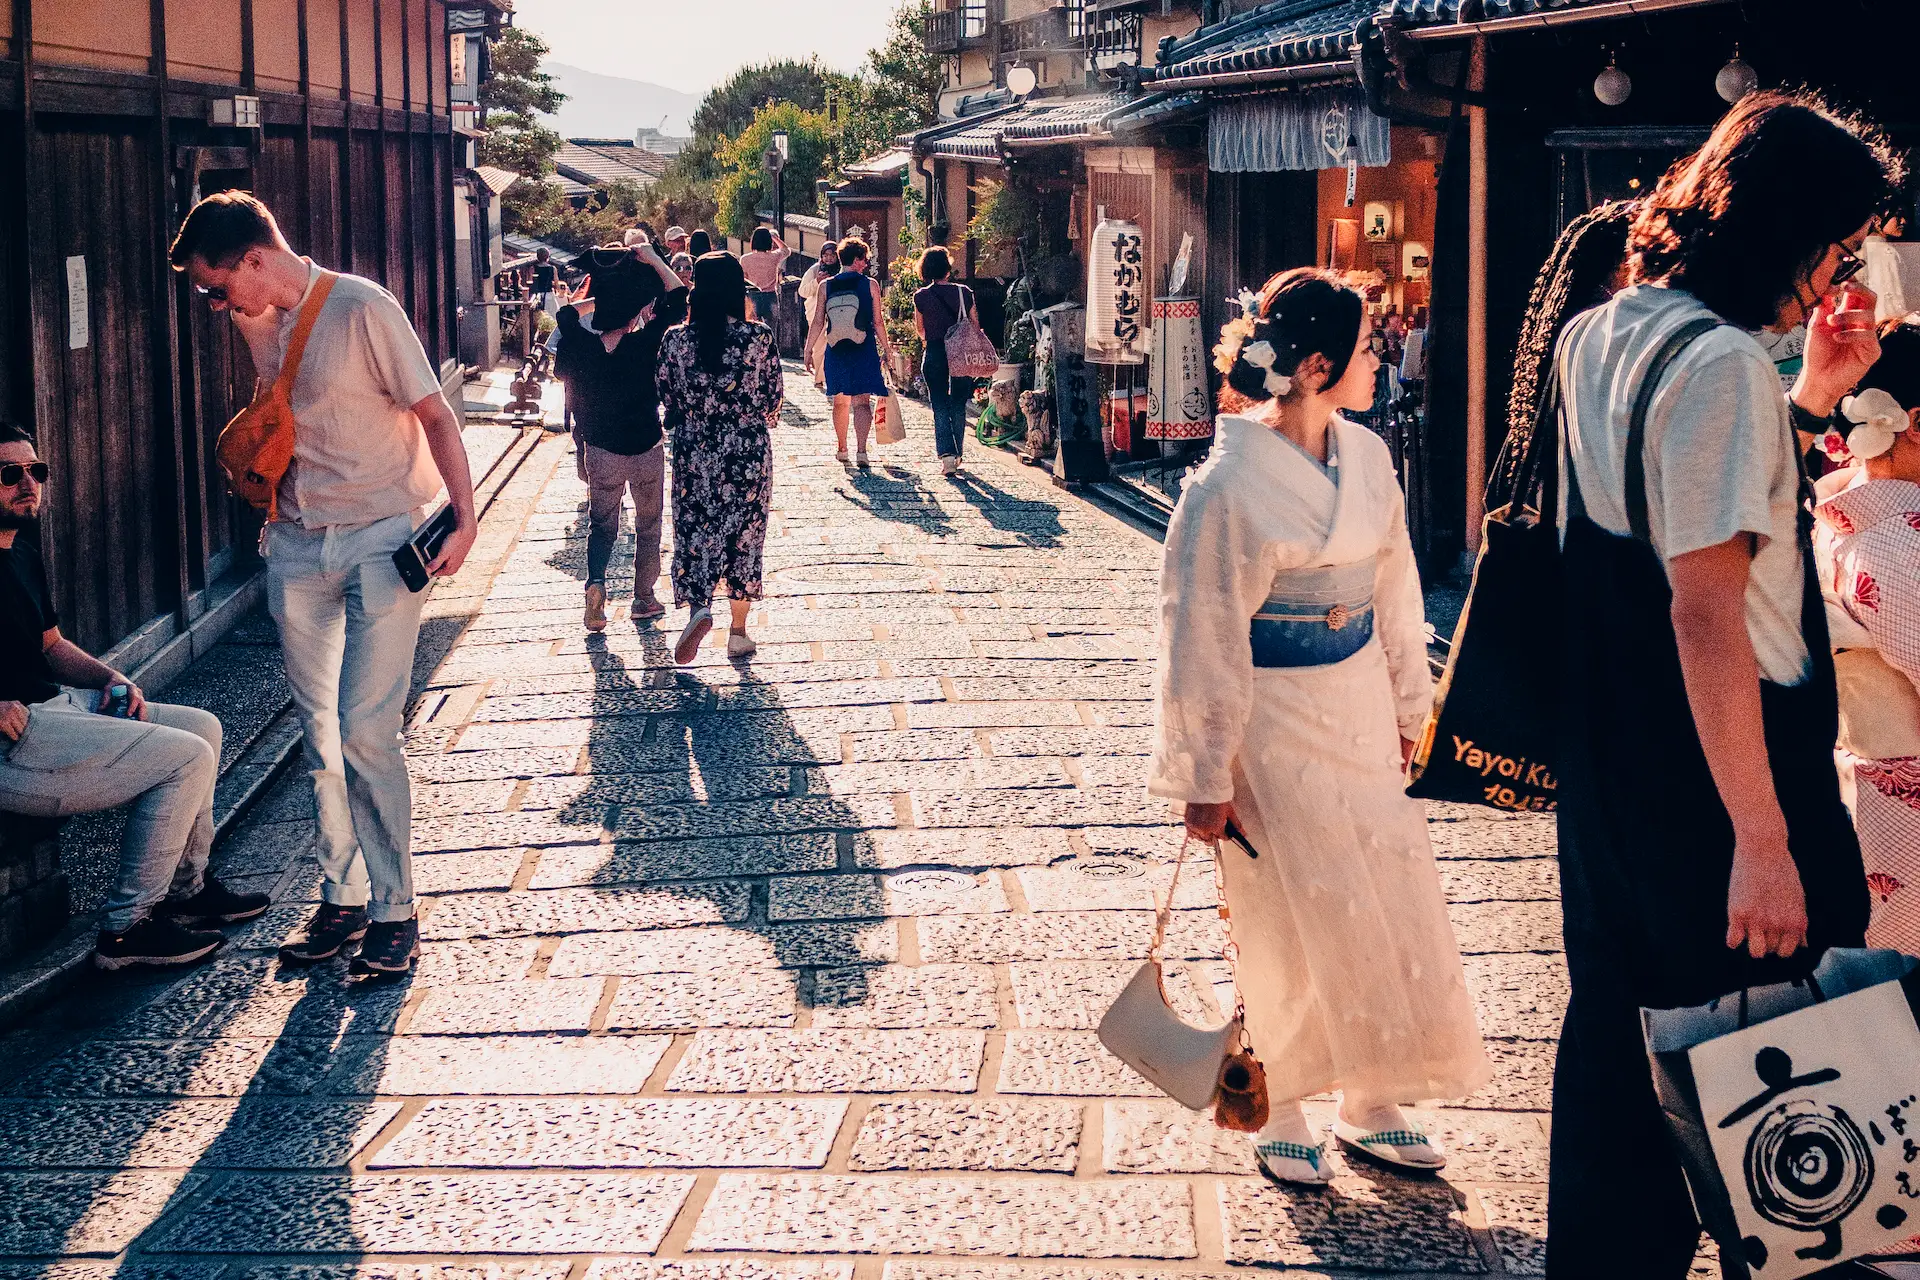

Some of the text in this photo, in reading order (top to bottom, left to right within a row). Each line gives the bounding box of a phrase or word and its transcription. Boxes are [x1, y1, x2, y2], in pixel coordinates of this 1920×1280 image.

[1111, 232, 1142, 342] なかむら
[1452, 735, 1526, 780] Yayoi
